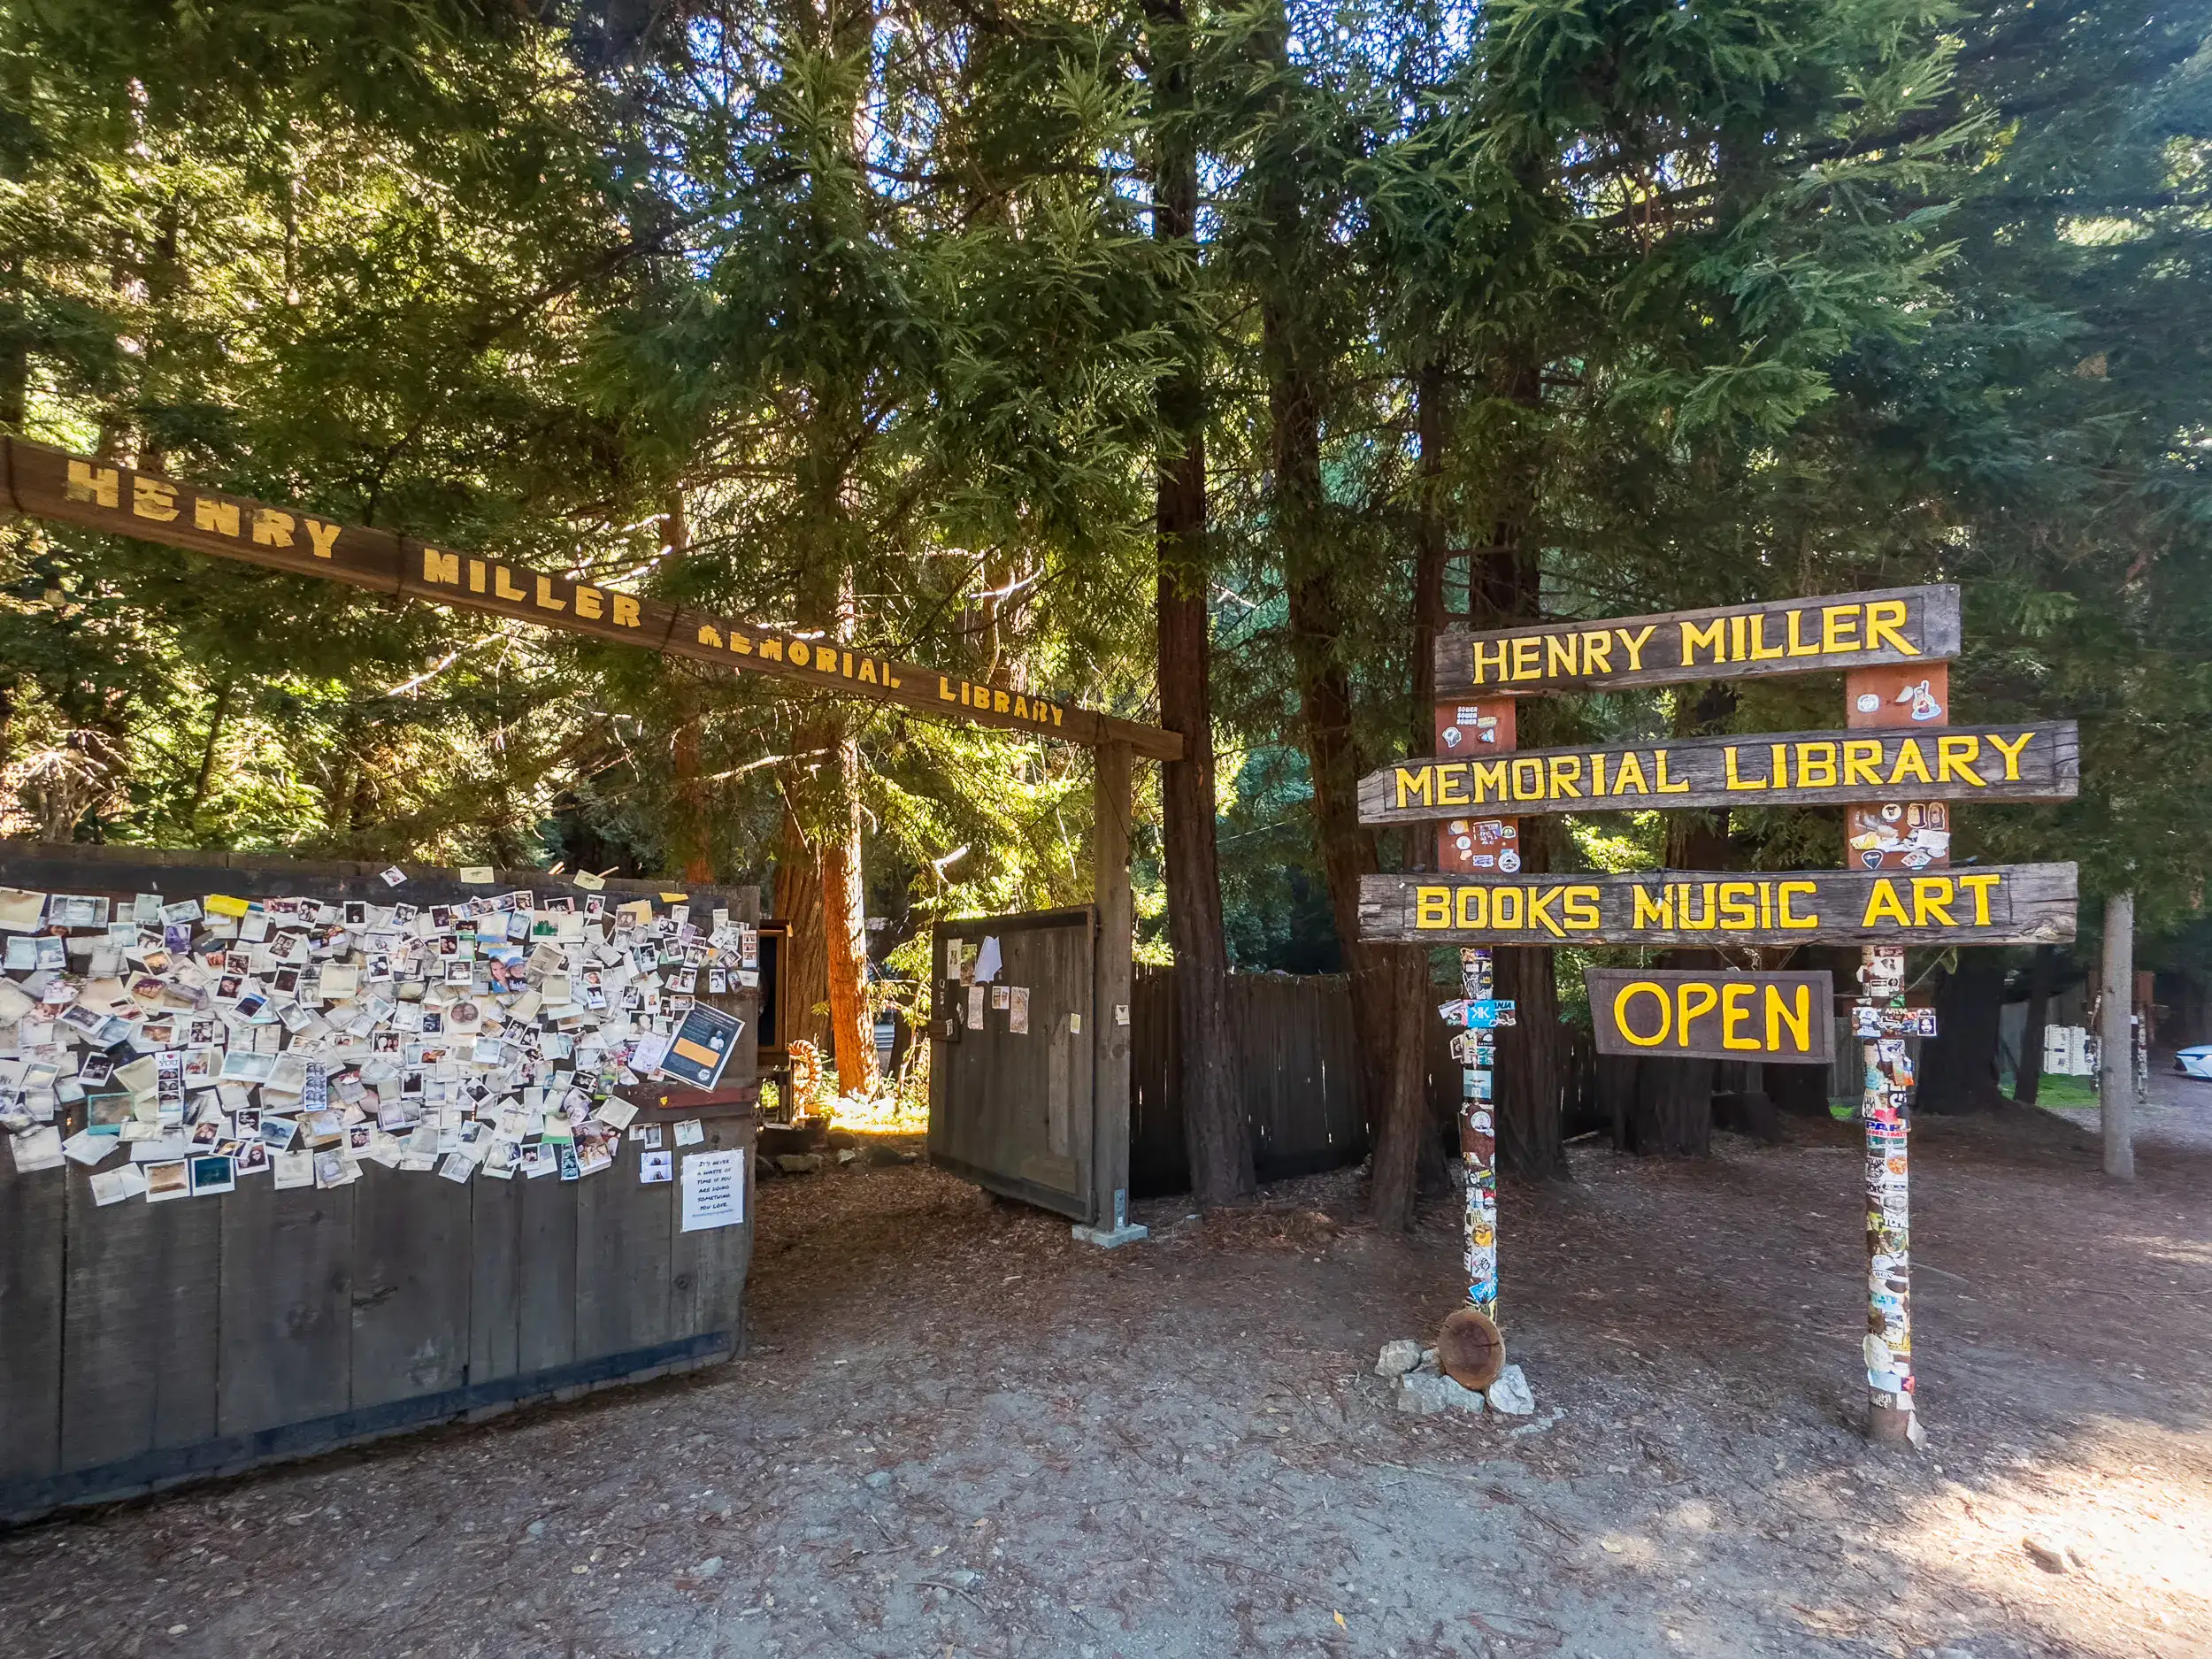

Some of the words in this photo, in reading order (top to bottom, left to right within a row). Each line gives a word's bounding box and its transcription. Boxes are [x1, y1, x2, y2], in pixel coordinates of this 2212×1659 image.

[67, 460, 342, 558] HENRY
[424, 549, 641, 627] MILLER
[698, 625, 902, 688] MEMORIAL
[939, 676, 1064, 726] LIBRARY
[1473, 626, 1655, 684] HENRY
[1681, 600, 1919, 666] MILLER
[1395, 750, 1690, 808] MEMORIAL
[1724, 732, 2035, 790] LIBRARY
[1416, 885, 1601, 938] BOOKS
[1632, 881, 1818, 930] MUSIC
[1862, 874, 2001, 927] ART
[1613, 981, 1810, 1052] OPEN
[697, 1193, 731, 1202] SOMETHING
